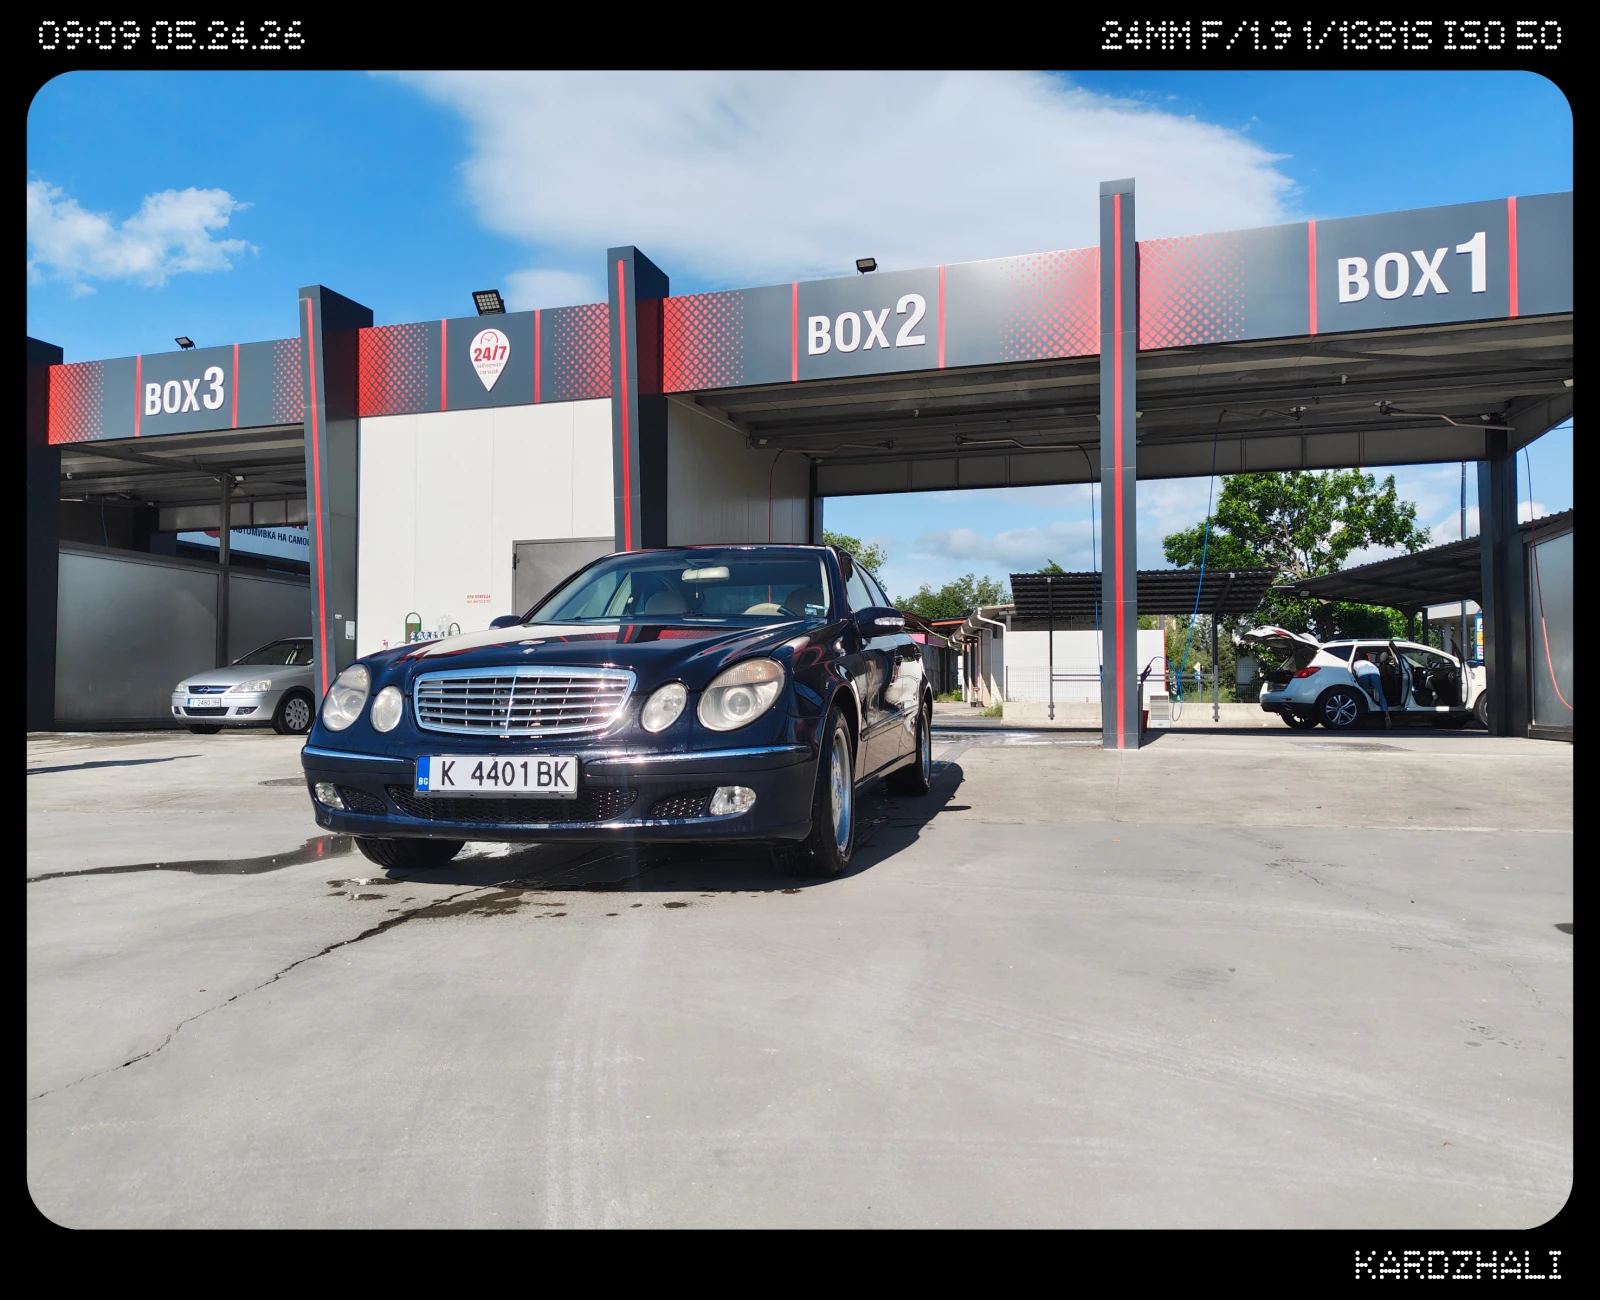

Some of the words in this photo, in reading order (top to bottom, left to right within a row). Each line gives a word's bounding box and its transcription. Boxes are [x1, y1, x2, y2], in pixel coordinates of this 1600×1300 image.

[474, 345, 507, 362] 24/7
[277, 533, 287, 543] НА
[418, 777, 429, 786] BG
